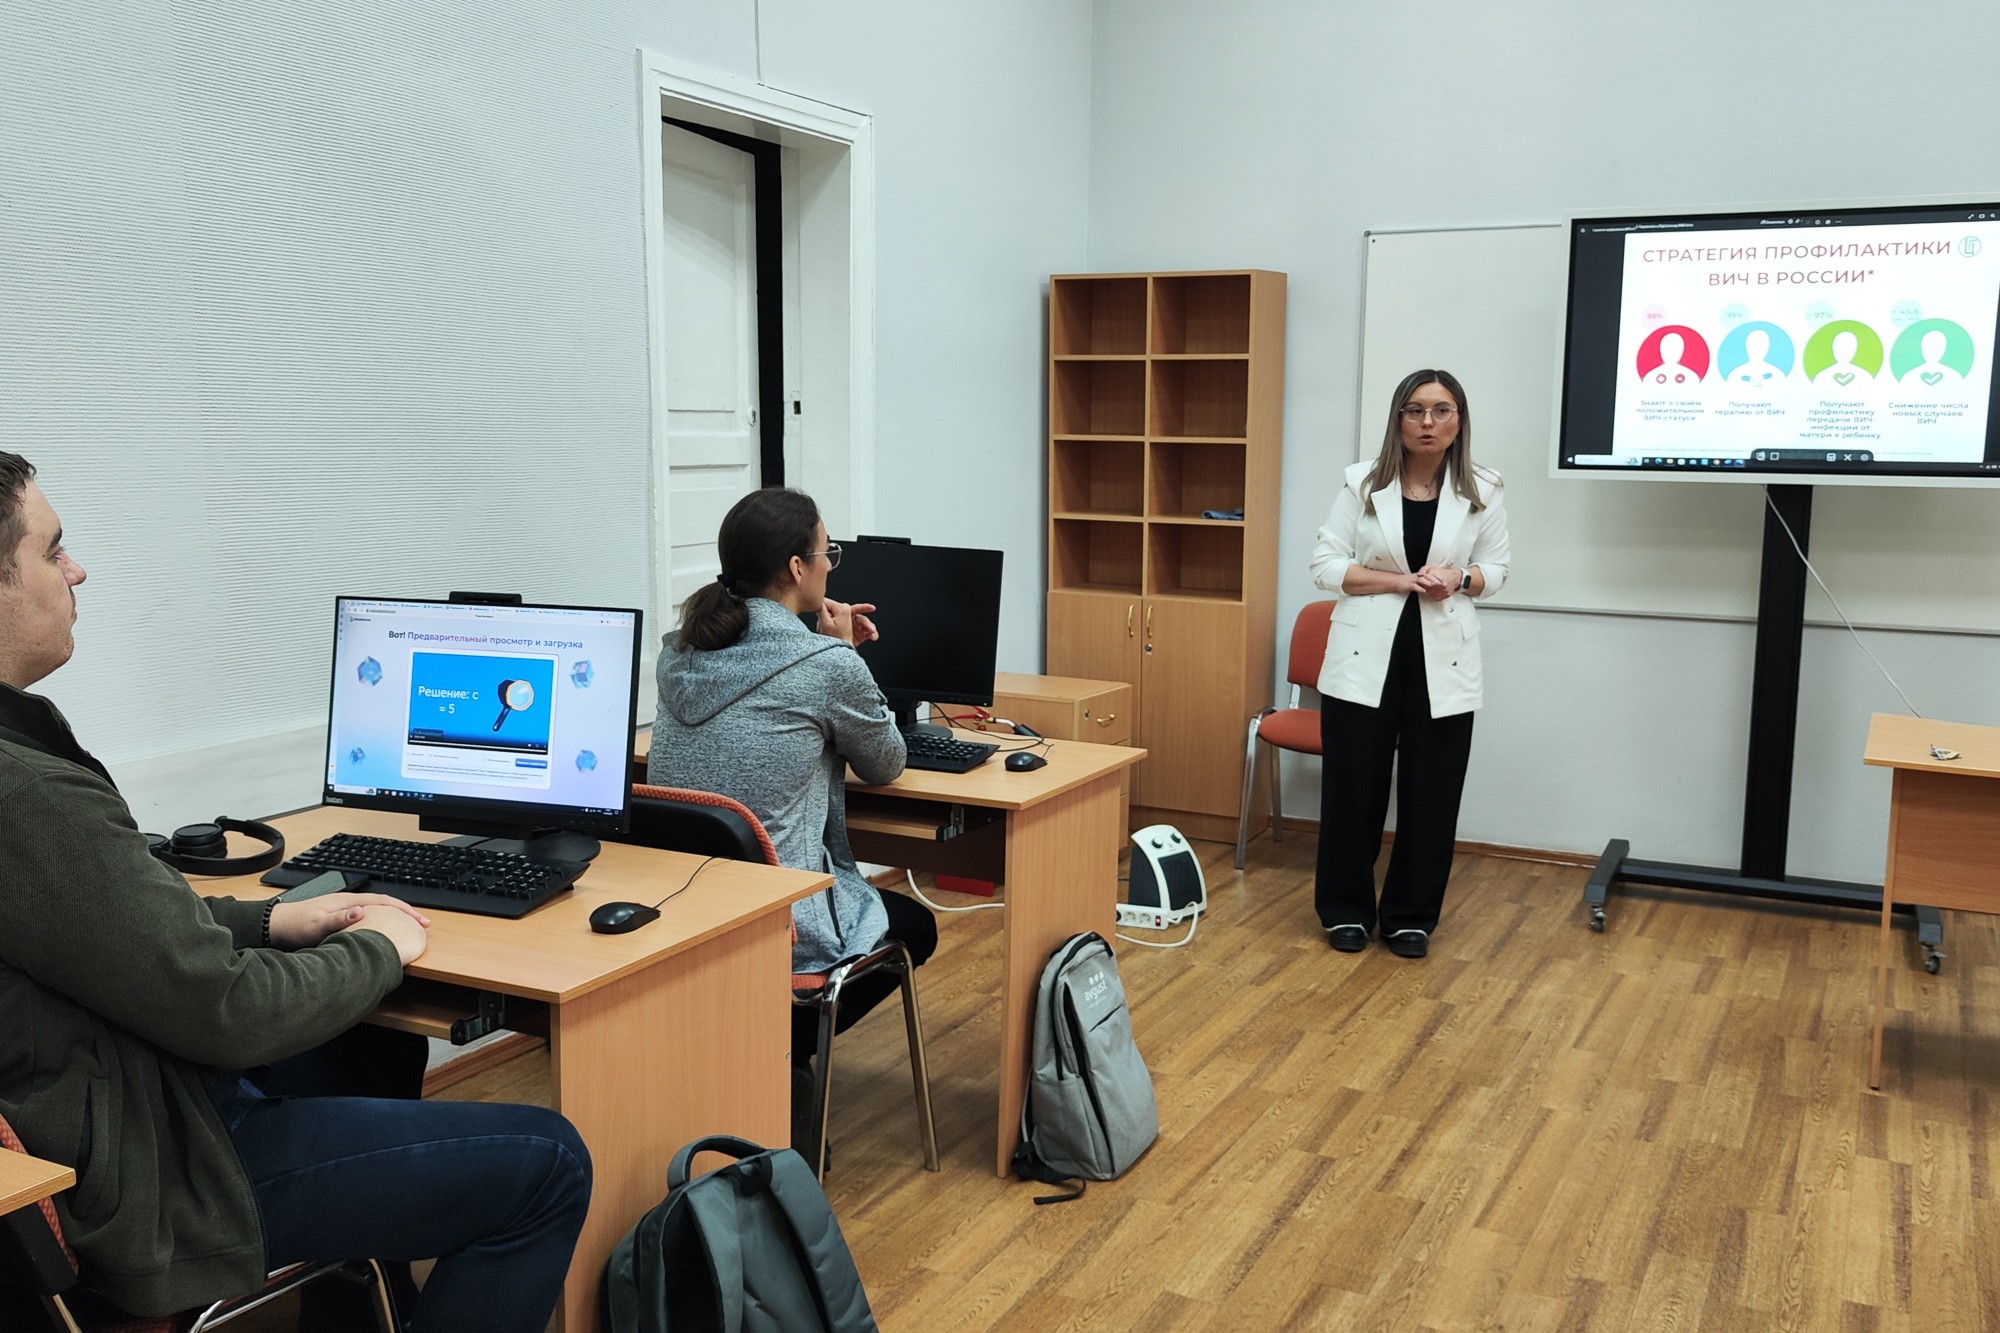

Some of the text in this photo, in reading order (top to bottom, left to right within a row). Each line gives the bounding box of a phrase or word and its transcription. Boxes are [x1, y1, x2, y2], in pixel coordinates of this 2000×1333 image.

[1643, 241, 1951, 262] СТРАТЕГИЯ ПРОФИЛАКТИКИ
[1708, 273, 1749, 286] ВИЧ
[1757, 272, 1769, 285] В
[388, 630, 406, 639] Вот!
[407, 631, 488, 644] Предварительный
[490, 637, 533, 647] просмотр
[544, 640, 583, 649] загрузка
[418, 685, 470, 700] Решение:
[448, 703, 455, 715] 5
[1083, 979, 1107, 1001] avgust
